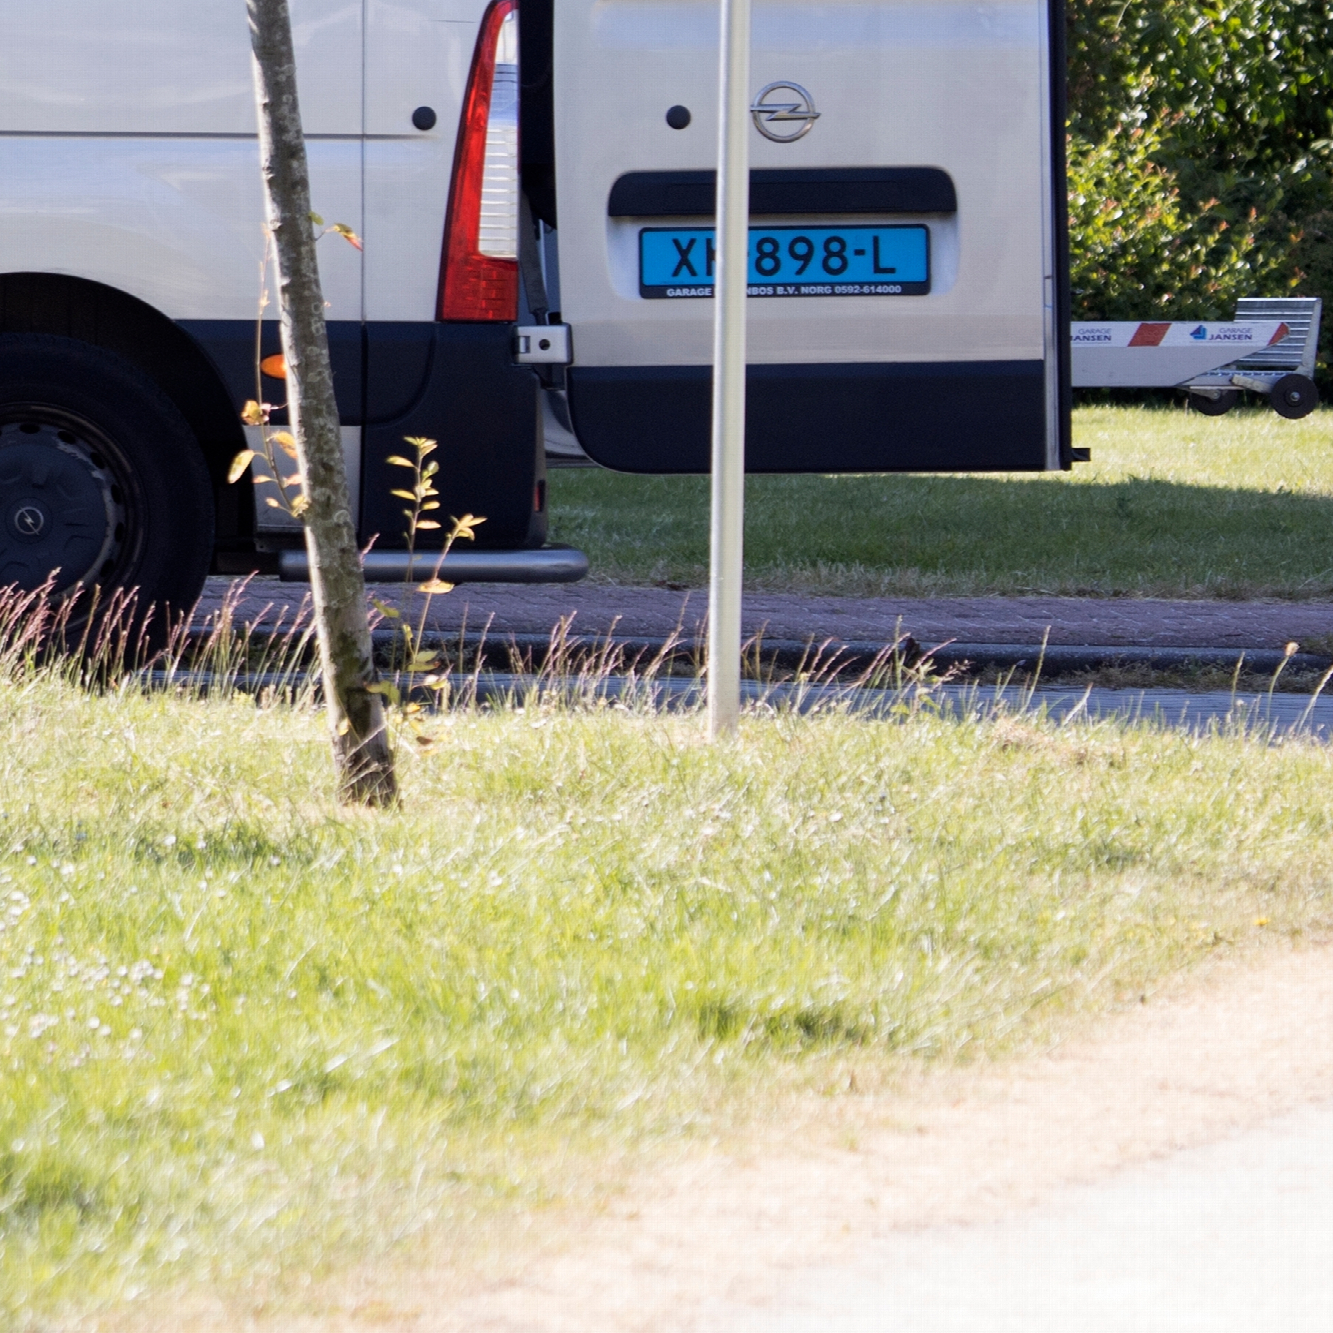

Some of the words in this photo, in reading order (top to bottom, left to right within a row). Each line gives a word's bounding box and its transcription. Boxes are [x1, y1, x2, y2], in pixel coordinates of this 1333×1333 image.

[666, 288, 712, 297] GARAGE
[776, 286, 798, 295] B.V.
[800, 286, 832, 294] NORG
[834, 285, 902, 294] 0592-614000
